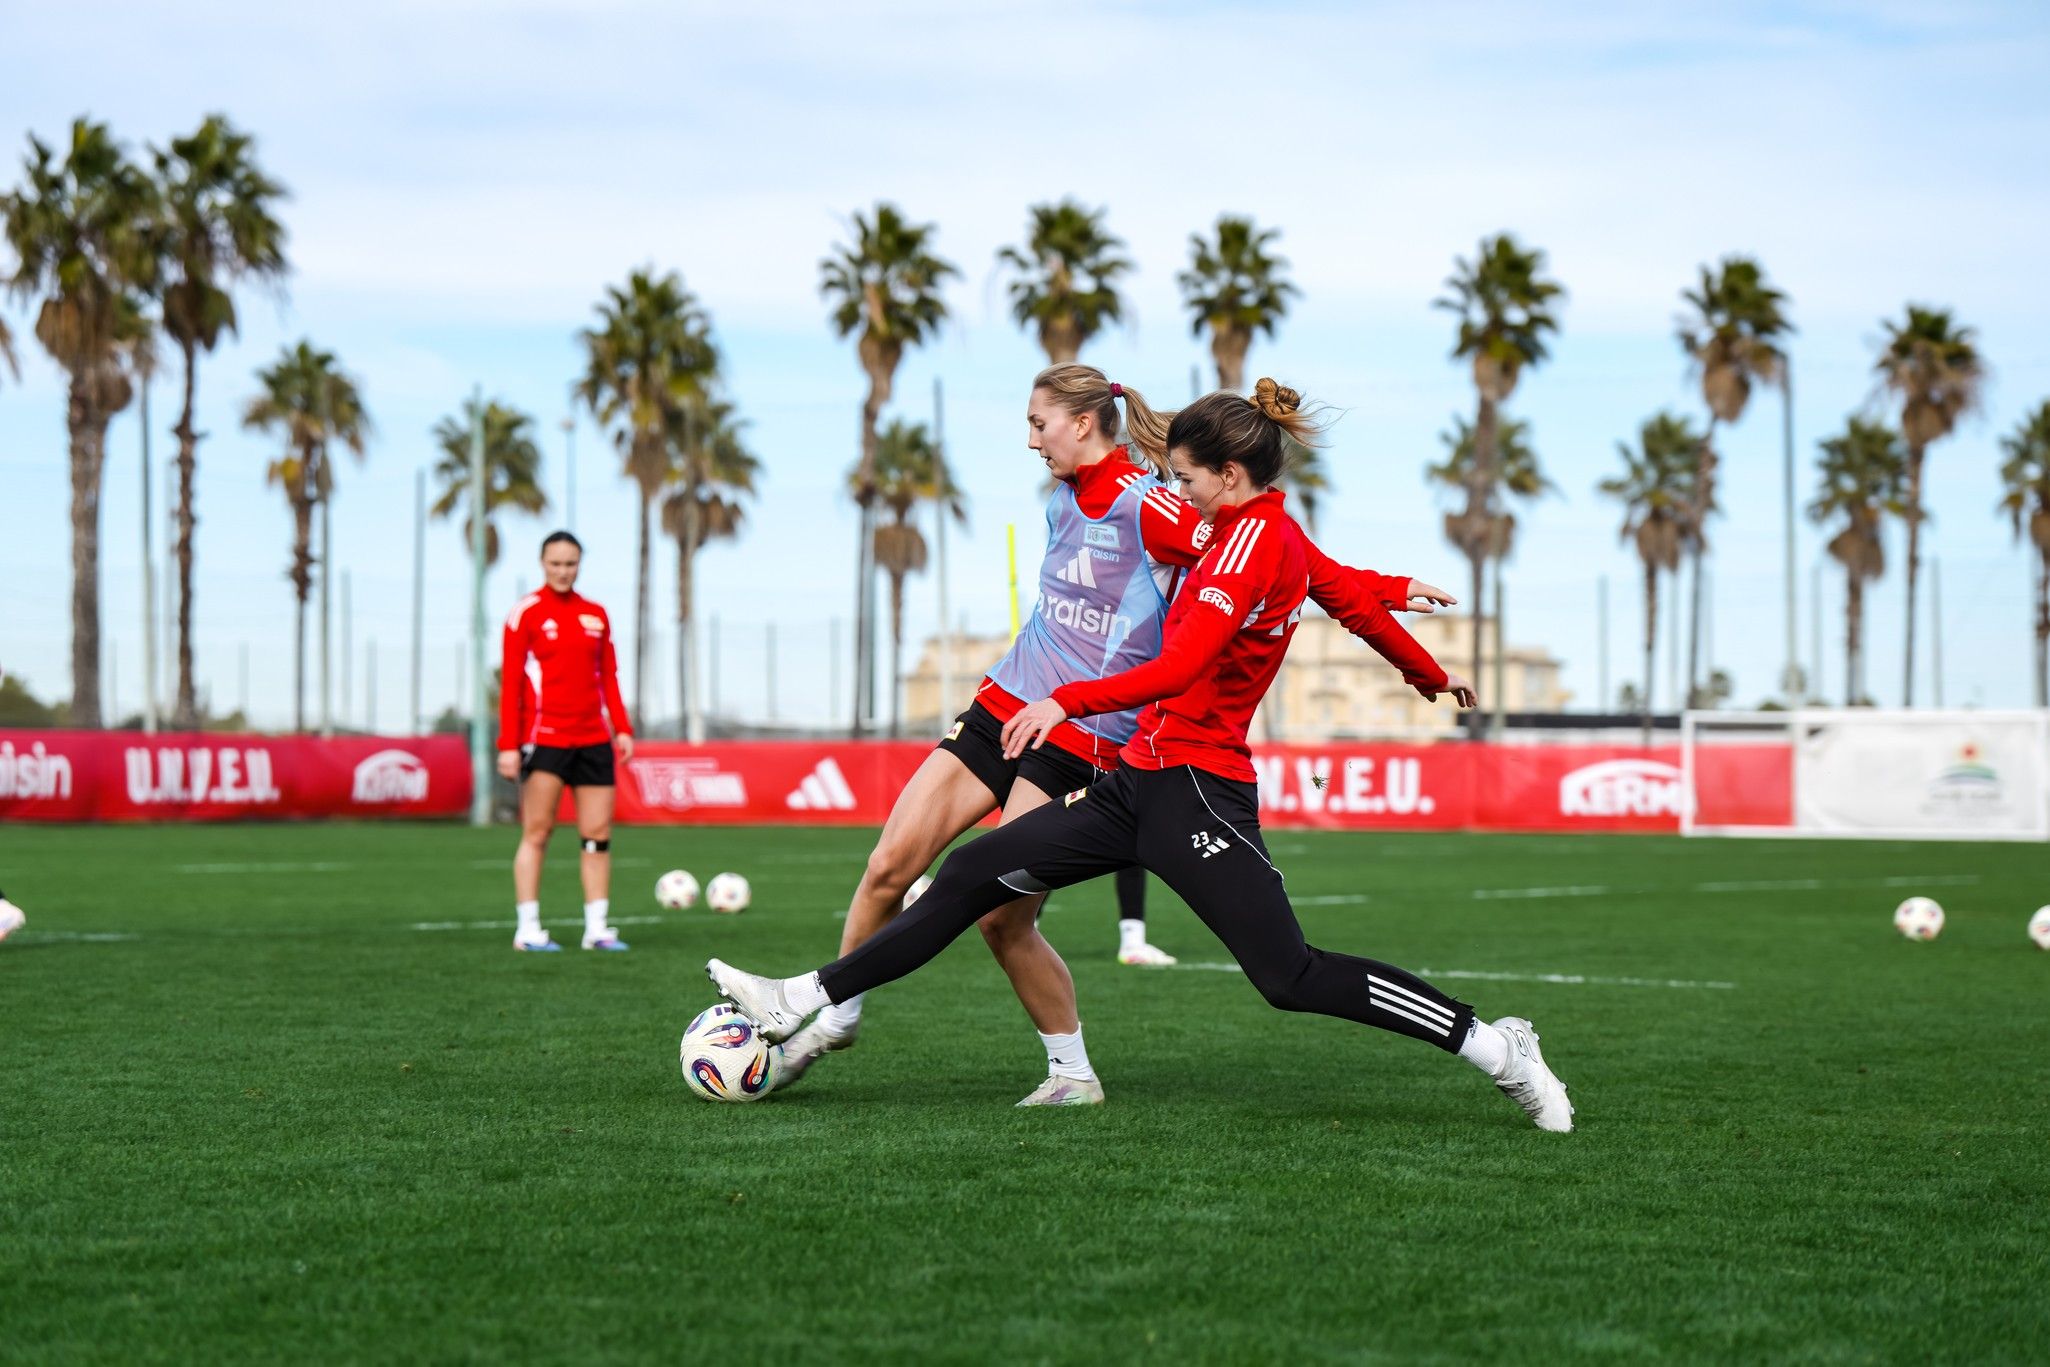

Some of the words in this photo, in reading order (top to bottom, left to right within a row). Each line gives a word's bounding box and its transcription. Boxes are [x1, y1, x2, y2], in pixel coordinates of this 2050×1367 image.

[1193, 521, 1215, 550] KER
[1045, 594, 1132, 640] raisin
[1197, 588, 1235, 616] KERMI
[0, 740, 73, 799] isin
[1254, 756, 1435, 815] N.V.E.U.
[1560, 763, 1692, 816] KERM
[1191, 831, 1210, 849] 23
